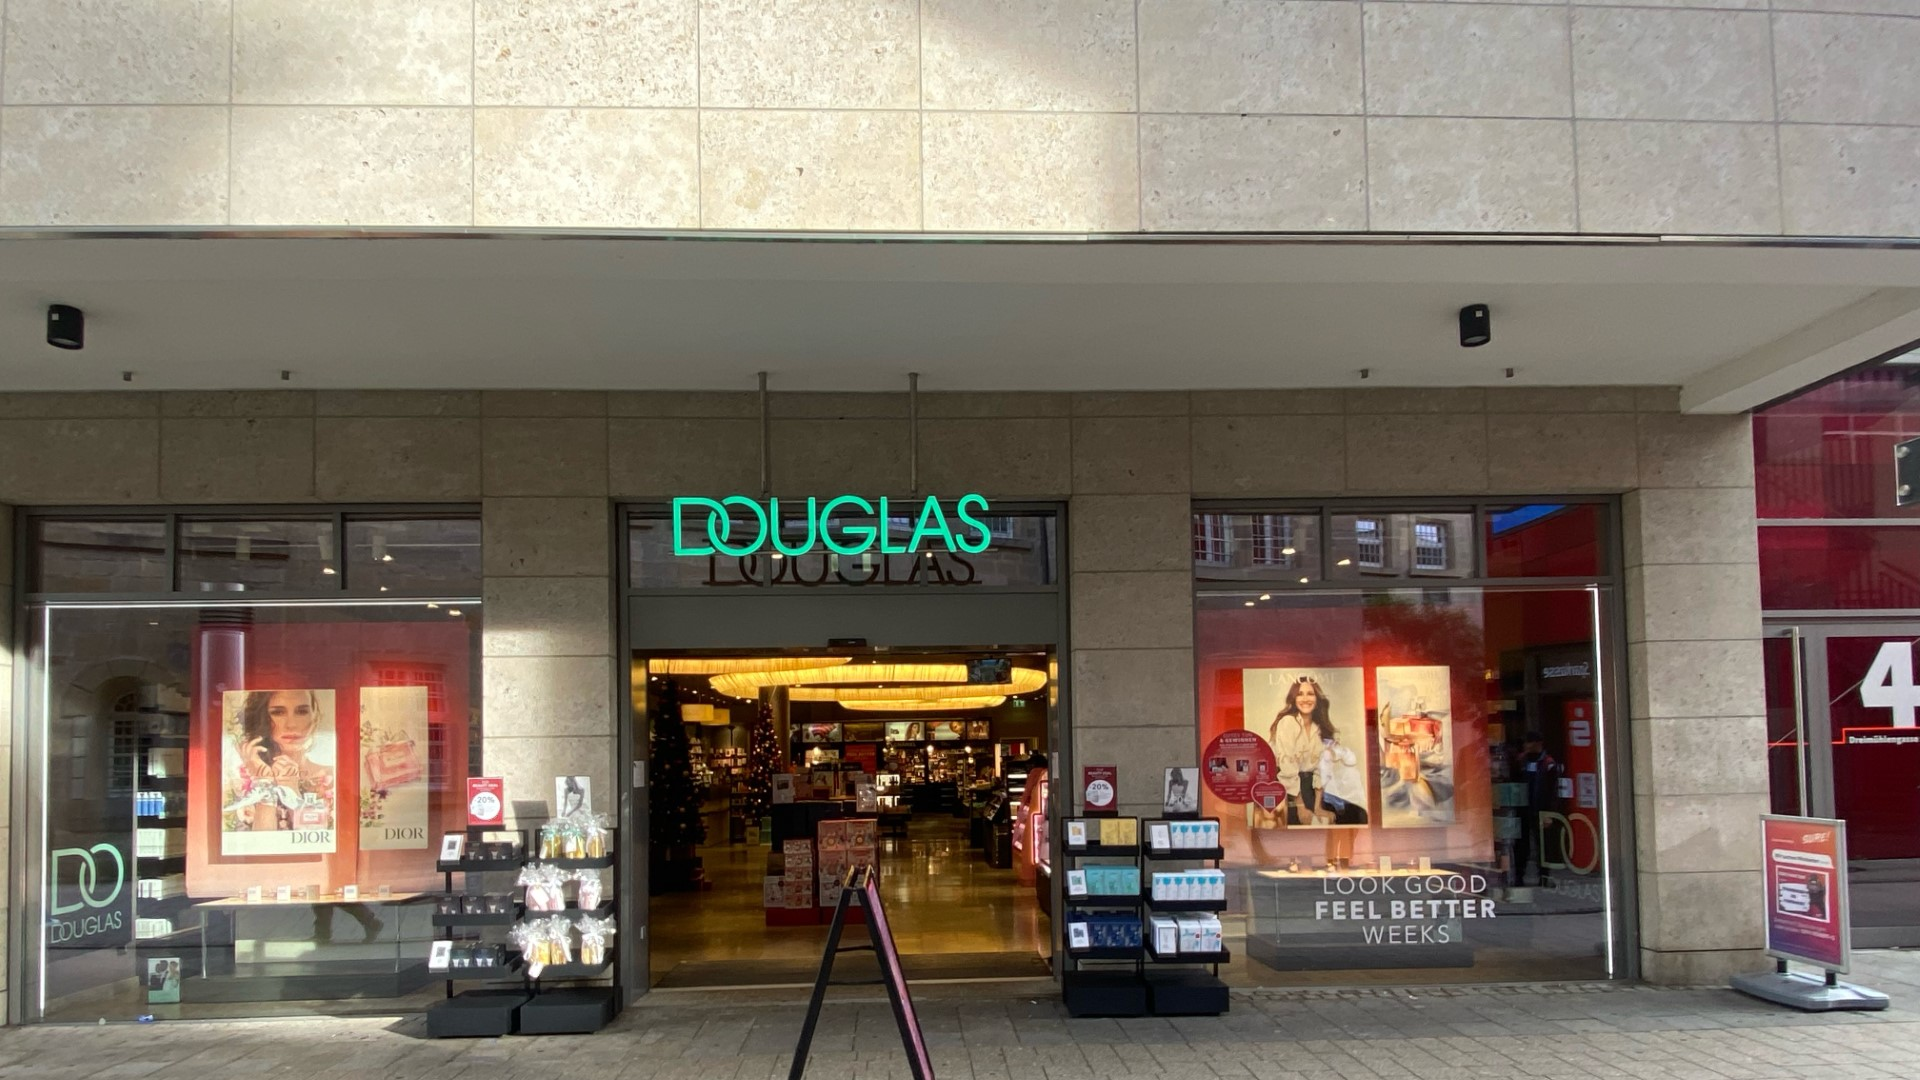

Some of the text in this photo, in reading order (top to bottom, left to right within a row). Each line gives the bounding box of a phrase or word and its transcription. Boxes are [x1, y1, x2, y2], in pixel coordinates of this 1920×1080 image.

[672, 493, 991, 557] DOUGLAS
[1859, 641, 1920, 728] 4
[291, 831, 331, 844] DIOR
[385, 828, 425, 841] DIOR
[1323, 874, 1487, 895] LOOK GOOD
[1315, 899, 1497, 920] FEEL BETTER
[51, 911, 122, 944] DOUGLAS
[1362, 925, 1450, 945] WEEKS
